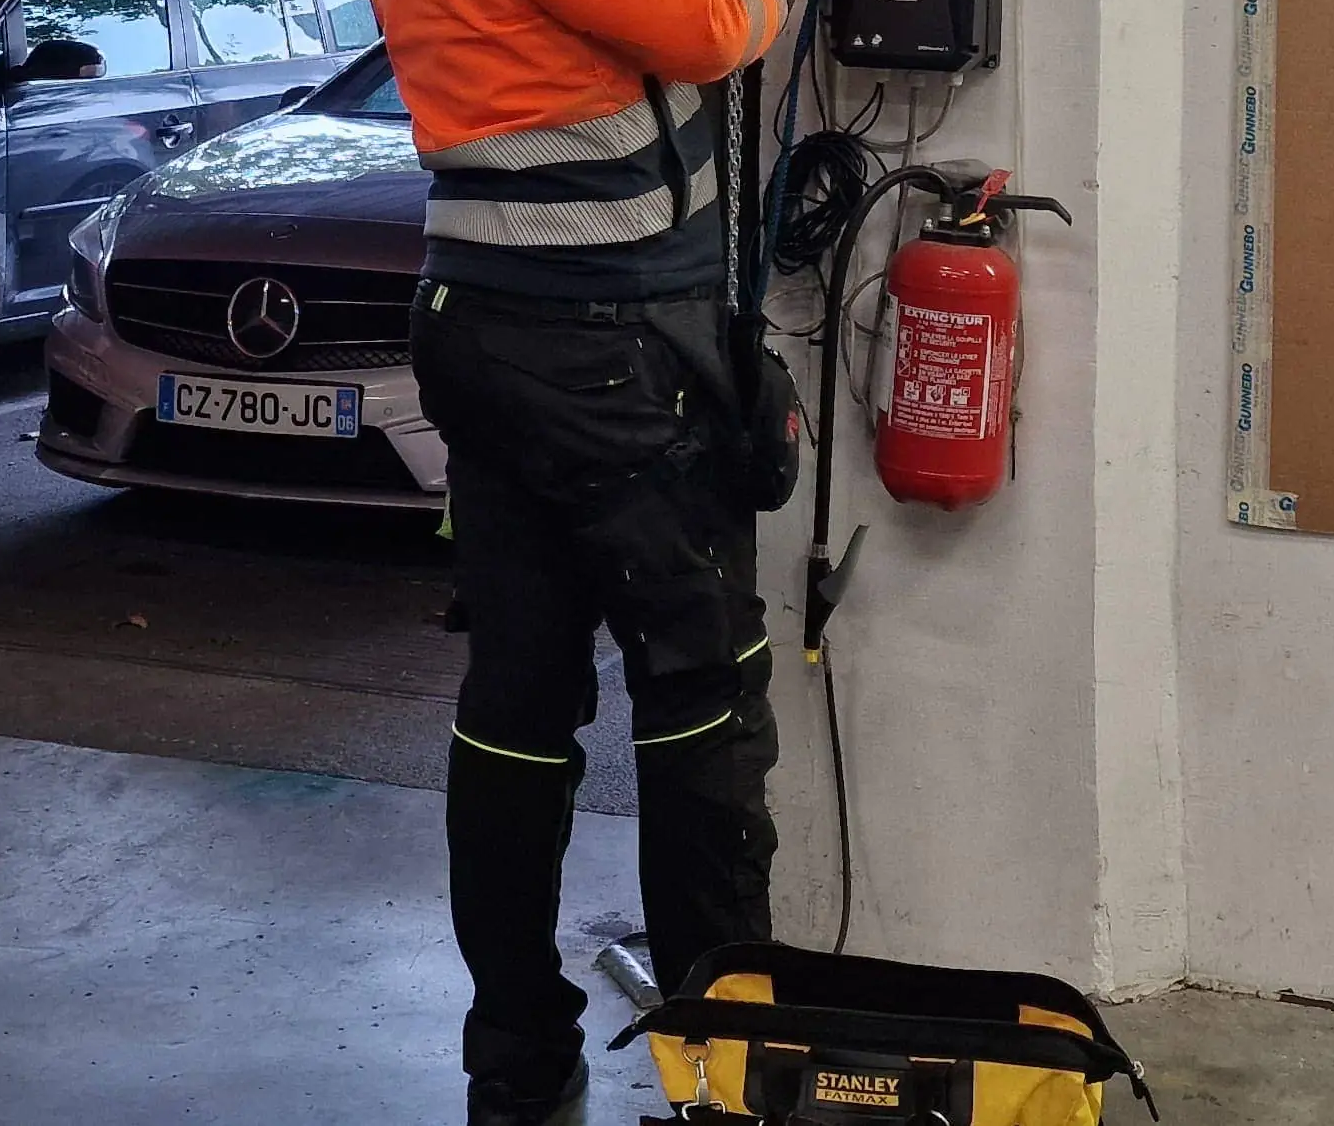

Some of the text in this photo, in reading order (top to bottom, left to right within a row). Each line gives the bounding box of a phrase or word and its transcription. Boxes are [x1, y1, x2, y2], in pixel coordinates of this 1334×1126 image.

[1241, 85, 1257, 155] GUNNEBO
[1240, 224, 1255, 294] GUNNEBO
[904, 306, 984, 326] EXTINCTEUR
[1238, 362, 1253, 432] GUNNEBO
[337, 414, 354, 431] 06
[817, 1072, 900, 1092] STANLEY
[824, 1090, 887, 1105] FATMAX
